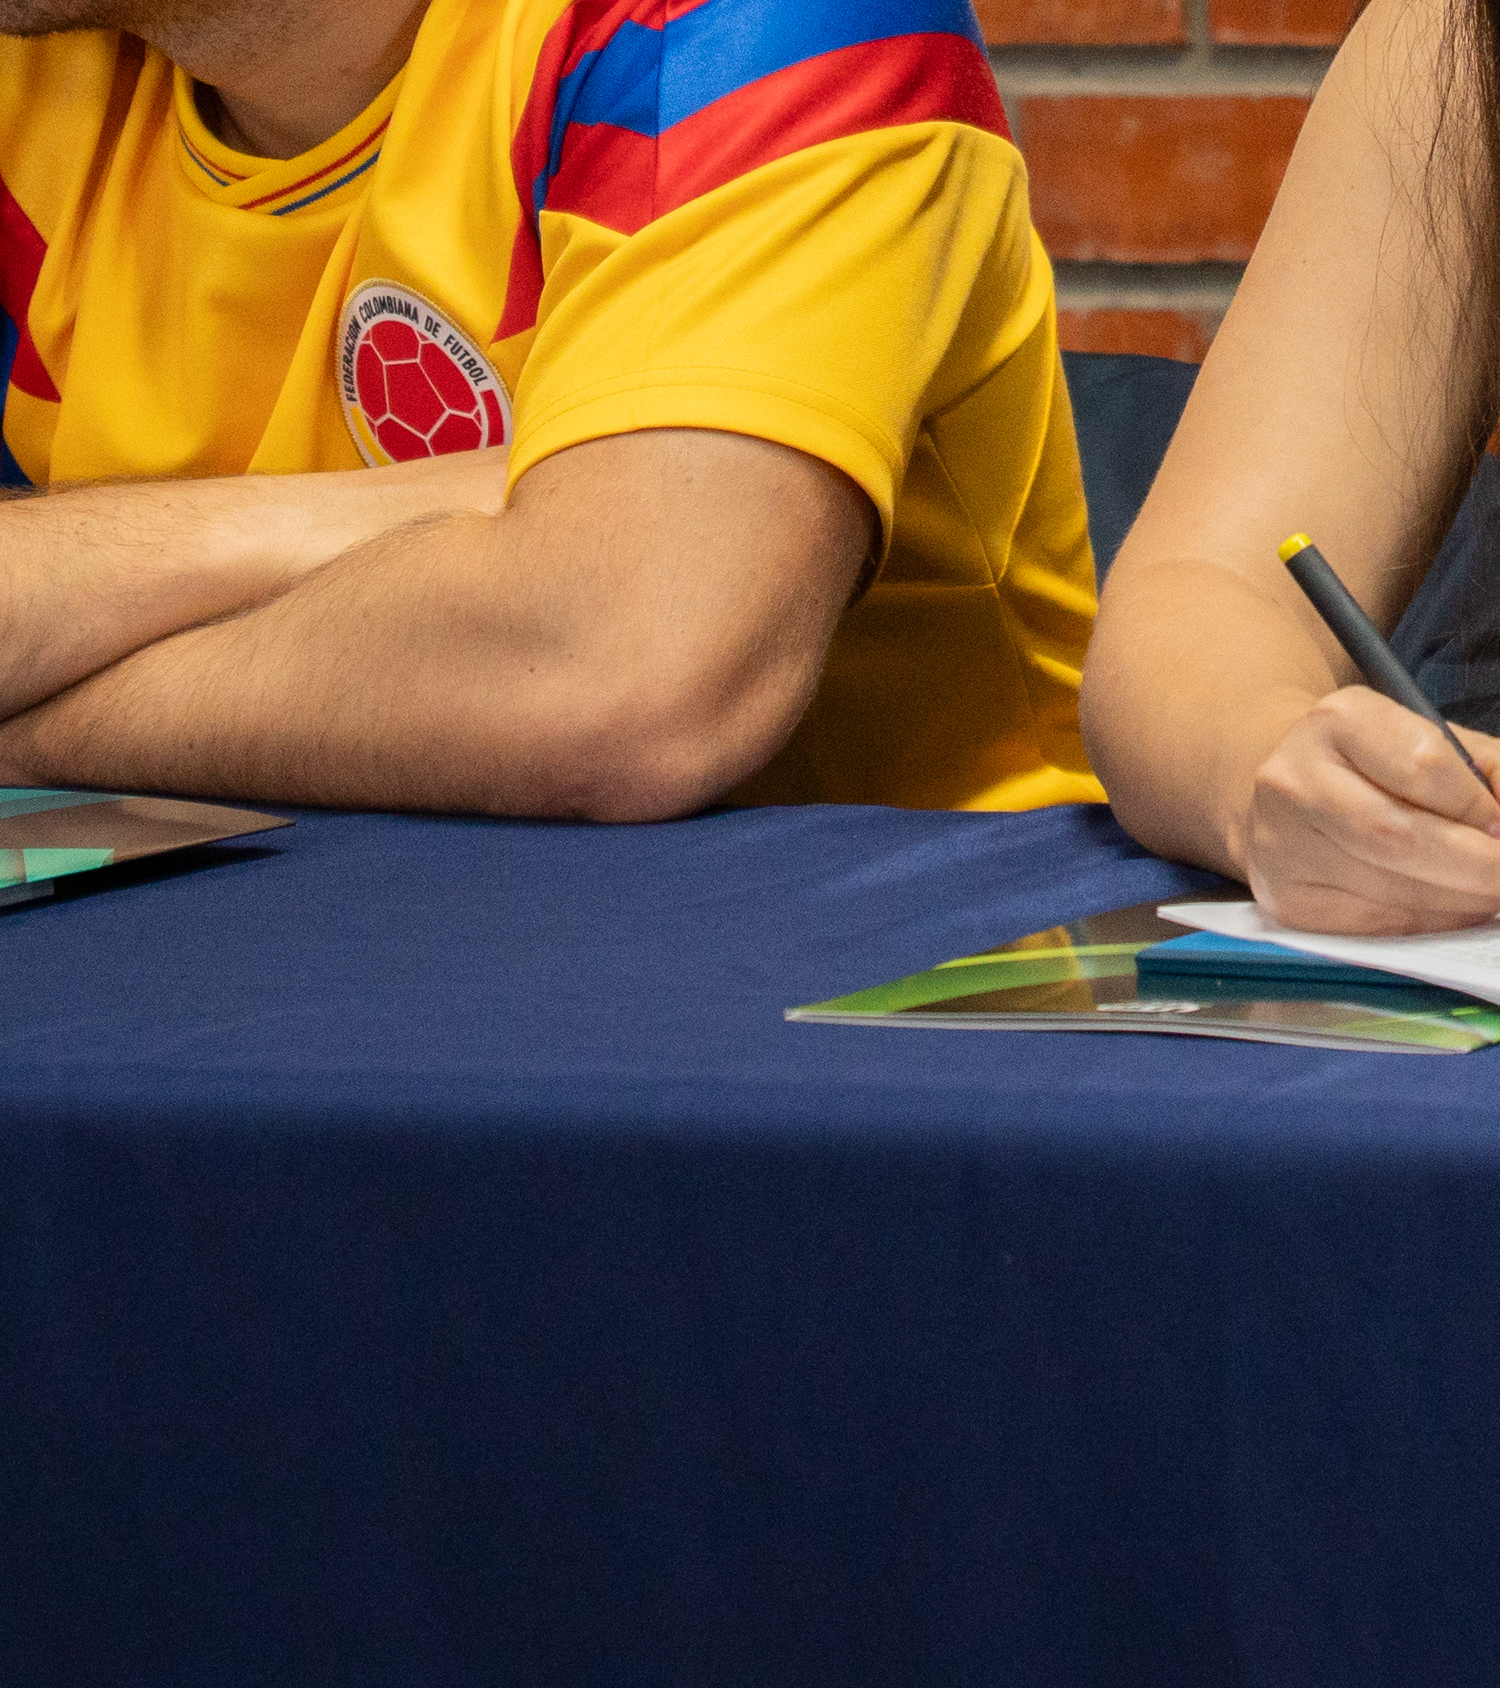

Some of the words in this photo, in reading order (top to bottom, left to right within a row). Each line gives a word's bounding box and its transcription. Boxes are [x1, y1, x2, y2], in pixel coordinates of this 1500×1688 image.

[358, 296, 419, 324] COLOMBIANA
[424, 315, 442, 338] DE
[443, 334, 488, 386] FUTBOL
